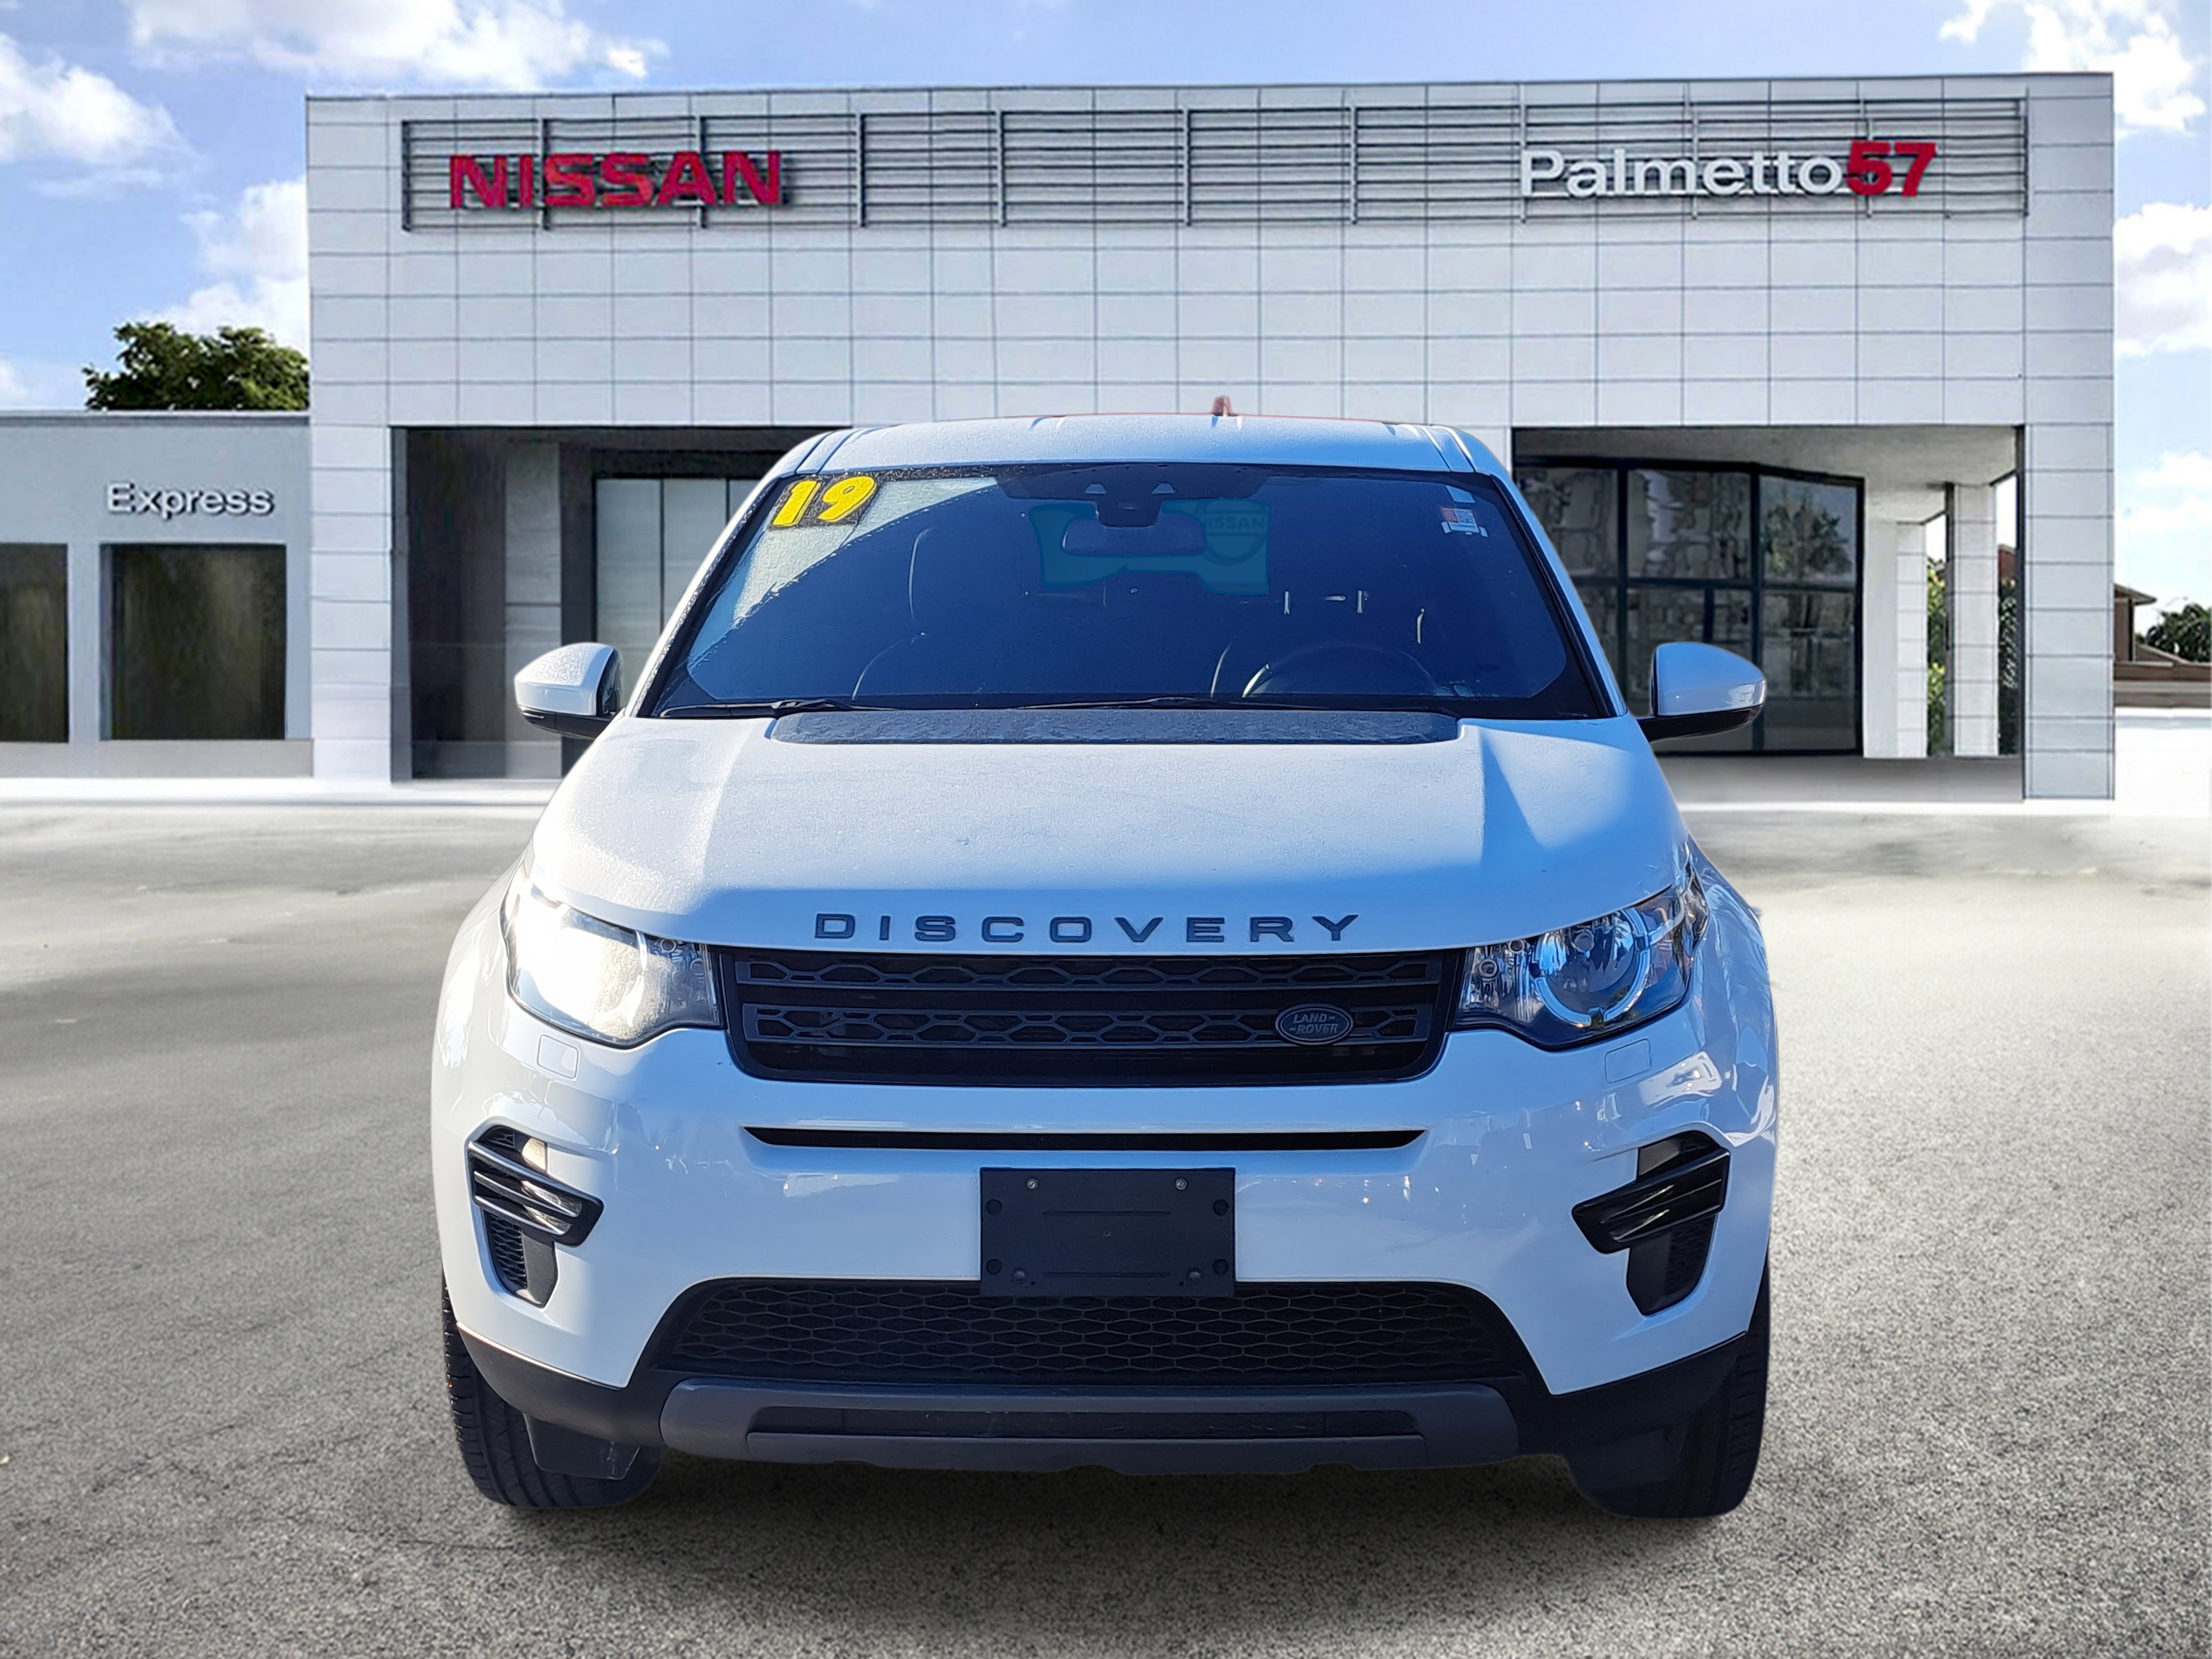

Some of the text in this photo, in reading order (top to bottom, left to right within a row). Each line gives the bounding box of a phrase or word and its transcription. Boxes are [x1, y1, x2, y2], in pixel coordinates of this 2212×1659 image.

[450, 149, 782, 209] NISSAN
[108, 482, 275, 520] Express
[772, 476, 877, 527] 19
[814, 913, 1359, 944] DISCOVERY
